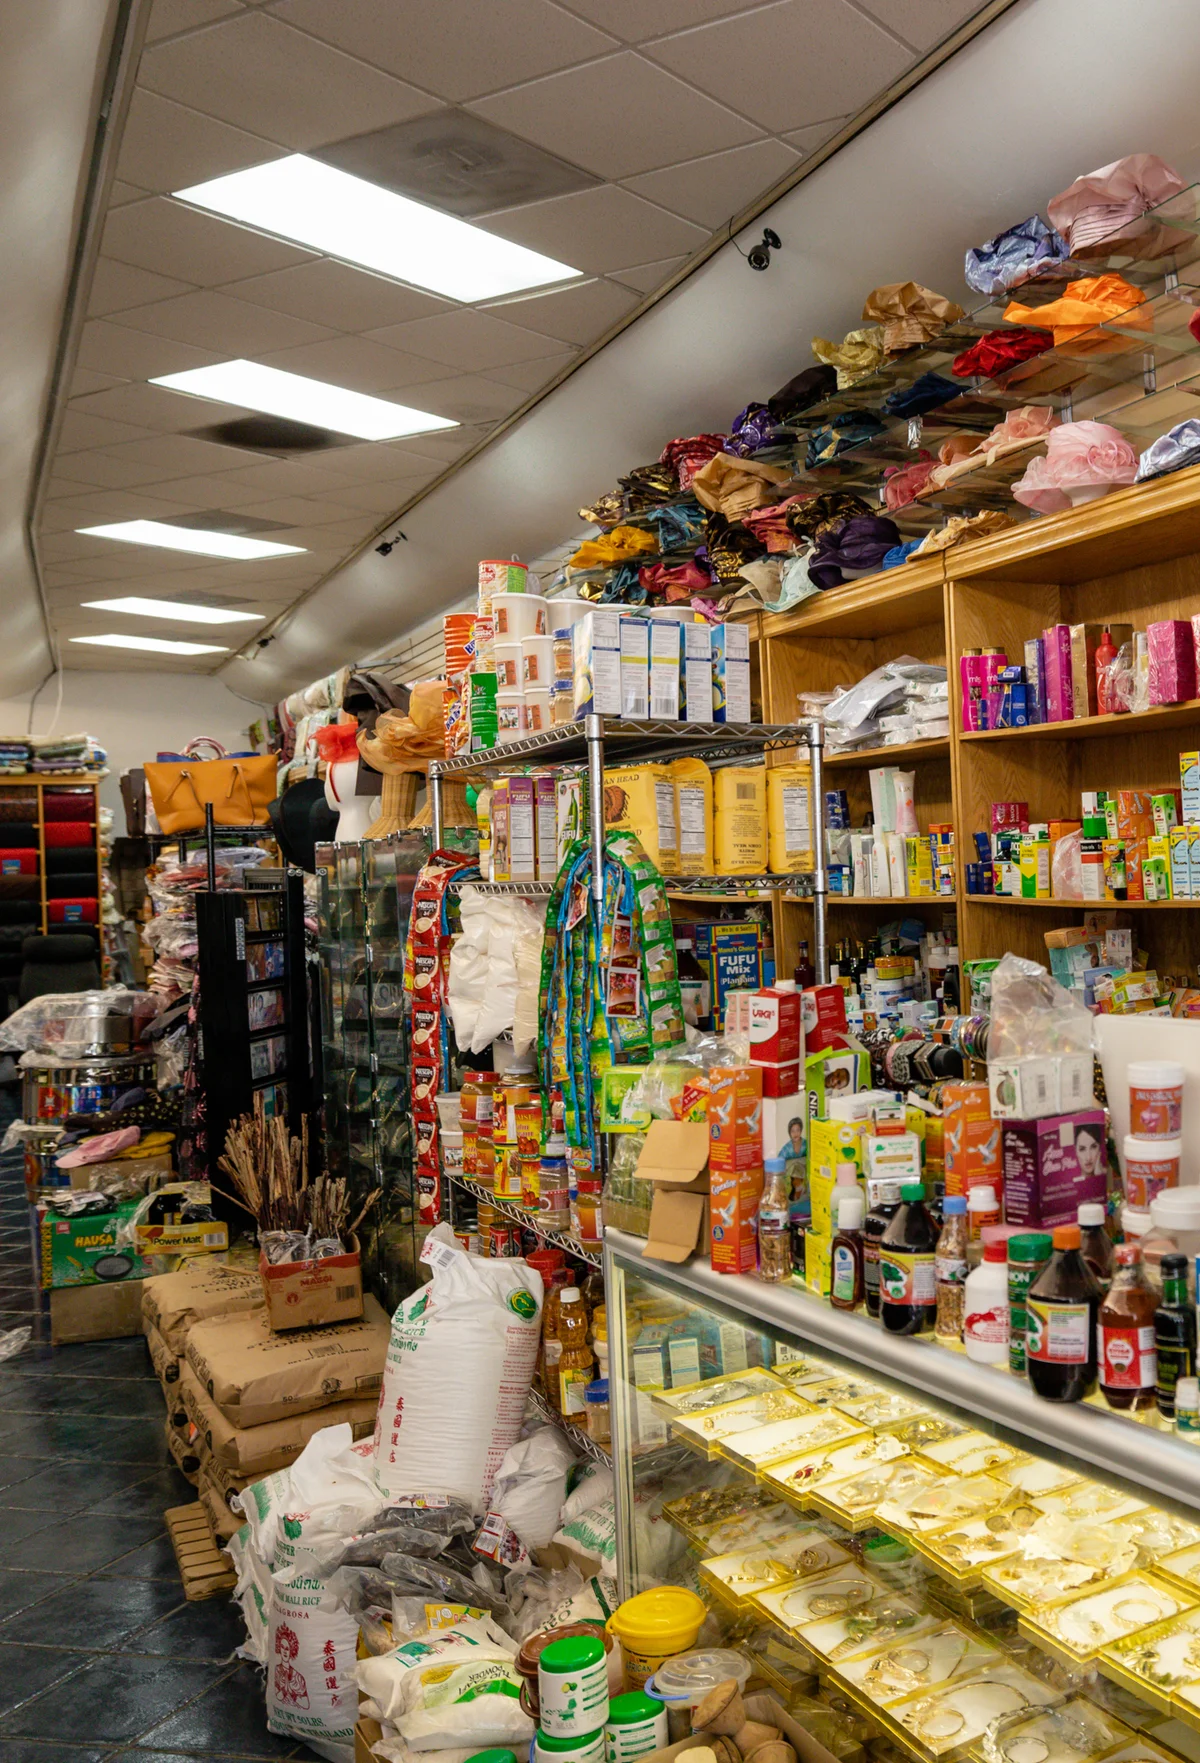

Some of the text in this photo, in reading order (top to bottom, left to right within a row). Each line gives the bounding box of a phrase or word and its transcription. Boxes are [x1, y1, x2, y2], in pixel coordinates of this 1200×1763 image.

[616, 774, 640, 784] HEAD
[720, 954, 756, 966] FUFU
[726, 965, 751, 974] Mix
[74, 1234, 114, 1247] HAUSA
[153, 1236, 202, 1245] Power Malt
[300, 1275, 333, 1287] MAGGI
[469, 1664, 503, 1681] POWDER
